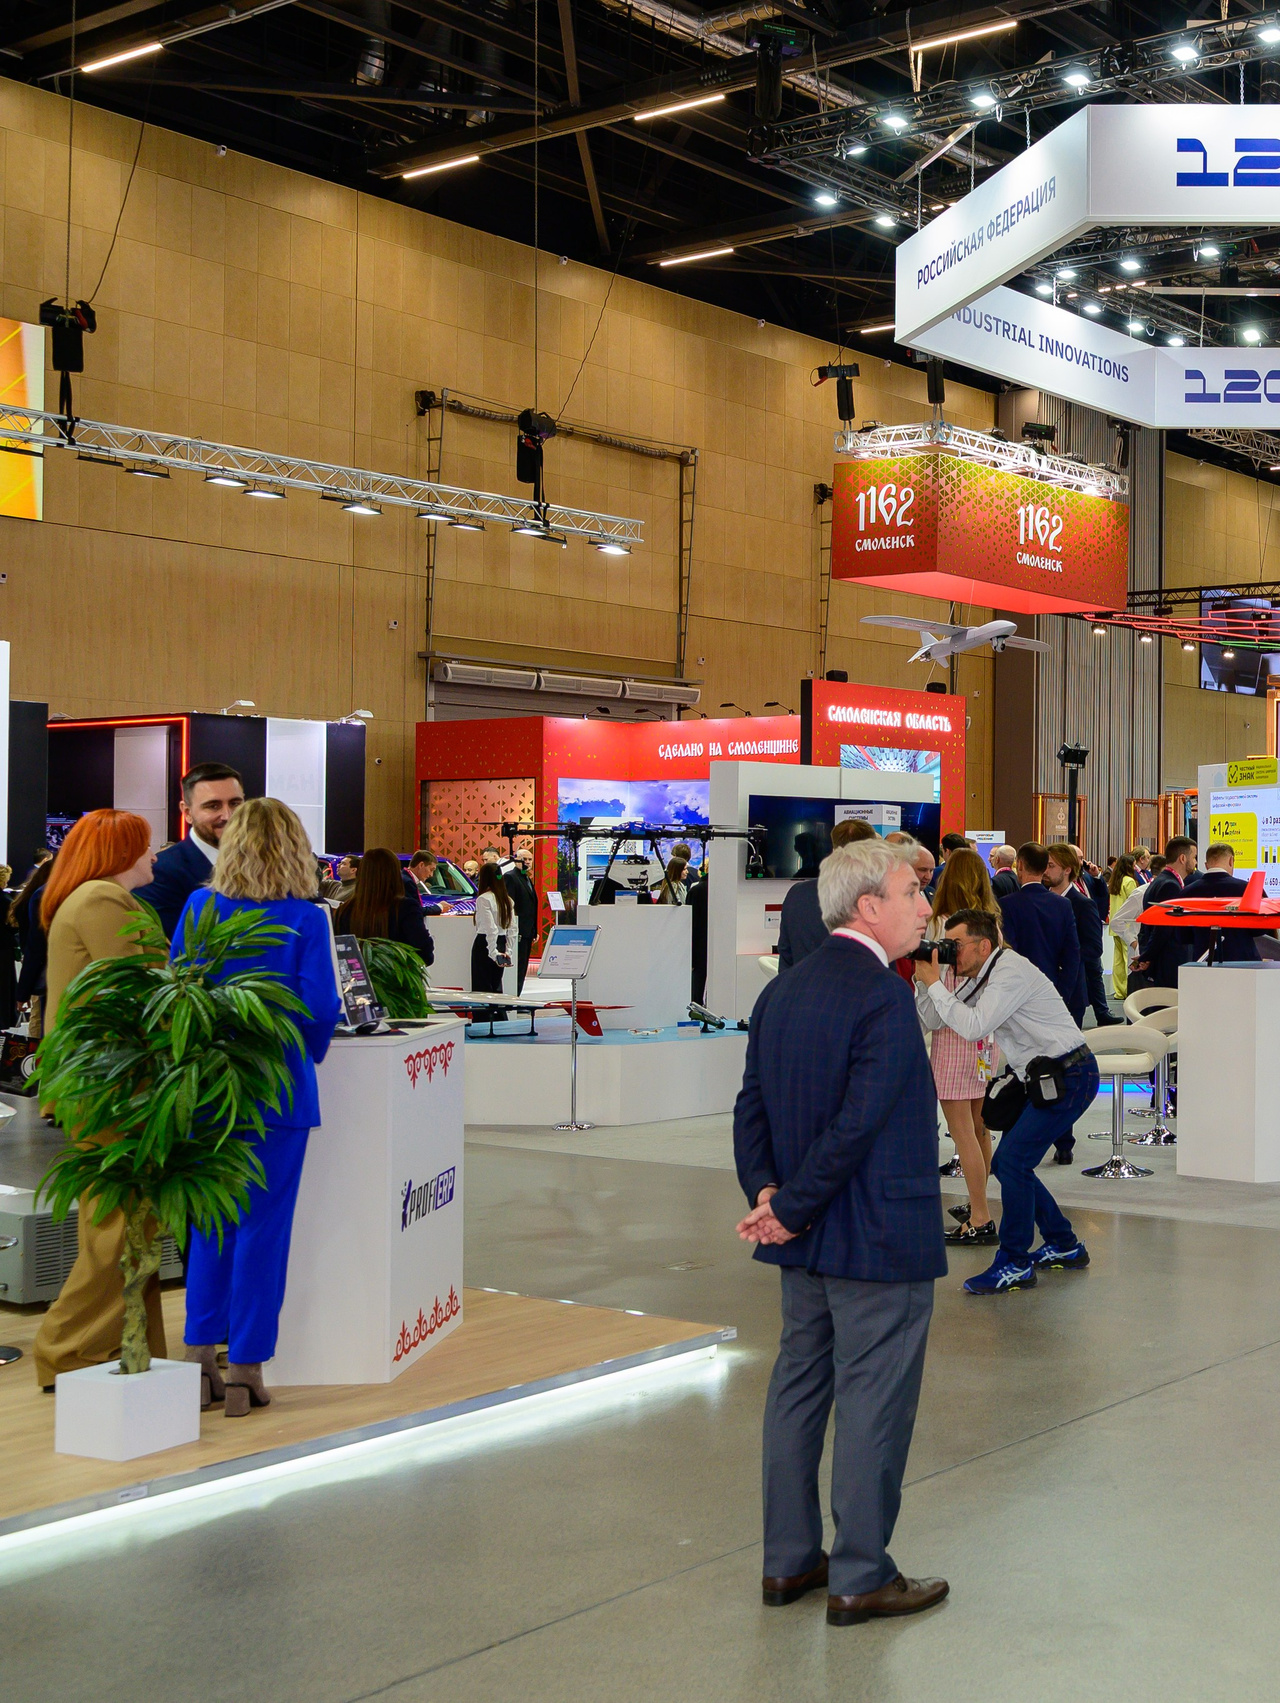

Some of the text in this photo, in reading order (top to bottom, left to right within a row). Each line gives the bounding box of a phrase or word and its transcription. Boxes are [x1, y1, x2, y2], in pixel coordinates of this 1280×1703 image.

[917, 176, 1056, 289] РОССИЙСКАЯ ФЕДЕРАЦИЯ
[951, 306, 1129, 382] NDUSTRIAL INNOVATIONS
[855, 483, 914, 531] 1162
[1017, 503, 1063, 552] 1162
[855, 534, 915, 552] СМОЛЕНСК
[1016, 551, 1063, 573] СМОЛЕНСК
[828, 705, 952, 732] СМОЛЕНСКАЯ ОБЛАСТЬ
[658, 739, 799, 760] СДЕЛАНО НА СМОЛЕНЩИНЕ
[1239, 772, 1255, 781] ЗНАК
[1212, 821, 1230, 838] +1,2
[1269, 878, 1278, 886] 650
